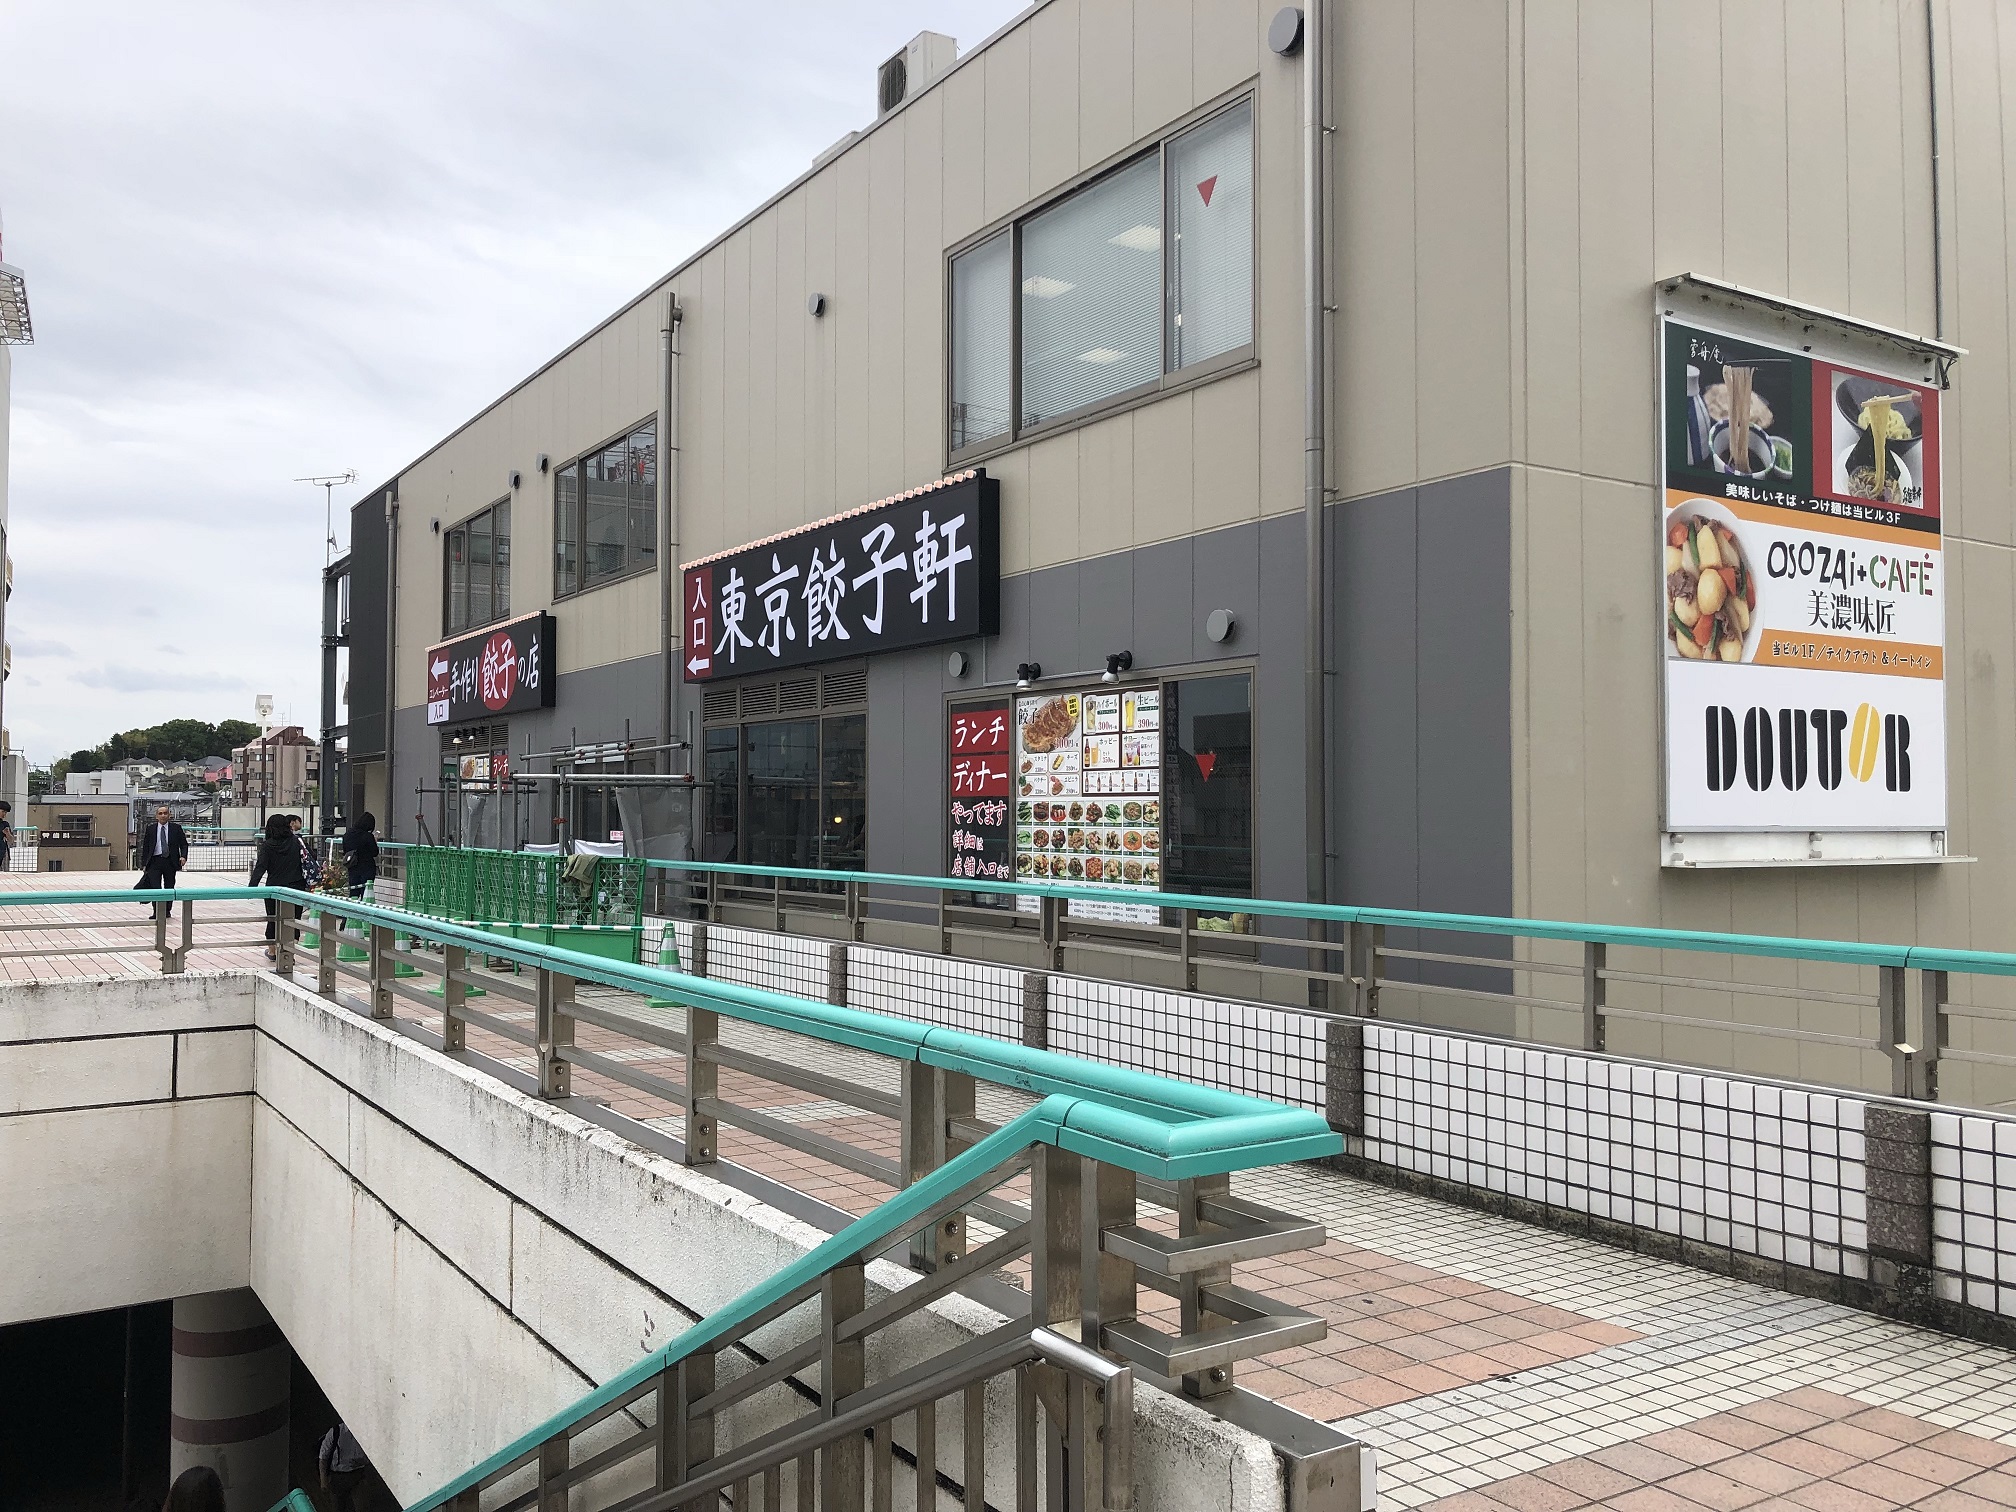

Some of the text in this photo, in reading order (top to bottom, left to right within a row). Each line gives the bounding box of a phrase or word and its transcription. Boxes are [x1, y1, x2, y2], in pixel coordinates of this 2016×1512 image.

[713, 510, 973, 664] 東京餃子軒
[692, 576, 707, 650] 入口
[1806, 589, 1897, 635] 美濃味匠
[433, 703, 444, 721] 入口
[1137, 694, 1159, 706] 生ビール
[954, 715, 1005, 748] ランチ
[1705, 702, 1911, 792] DOUTOR
[493, 758, 509, 775] ランチ
[953, 760, 1007, 792] ディナー
[951, 800, 1008, 827] やってます
[952, 829, 984, 852] 詳細は
[951, 853, 1010, 879] 店舗入口まで
